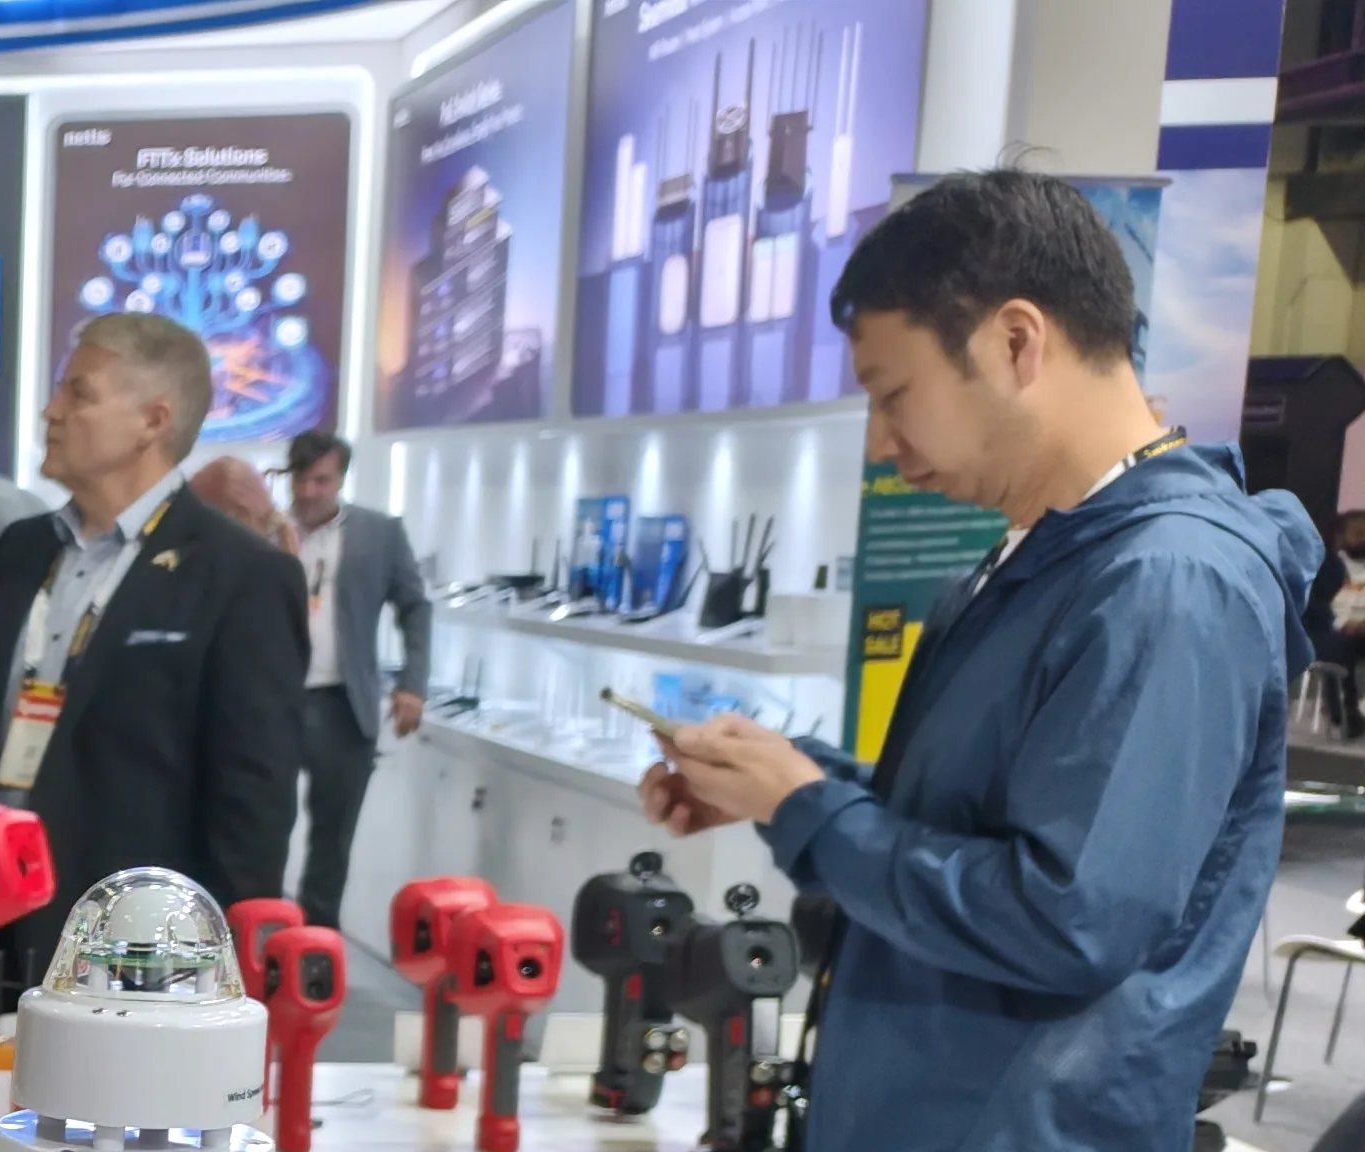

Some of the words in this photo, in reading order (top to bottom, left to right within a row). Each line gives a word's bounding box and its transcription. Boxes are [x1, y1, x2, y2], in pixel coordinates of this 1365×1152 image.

[63, 128, 112, 147] netis
[184, 146, 269, 167] Solutions
[227, 1090, 246, 1102] Wind
